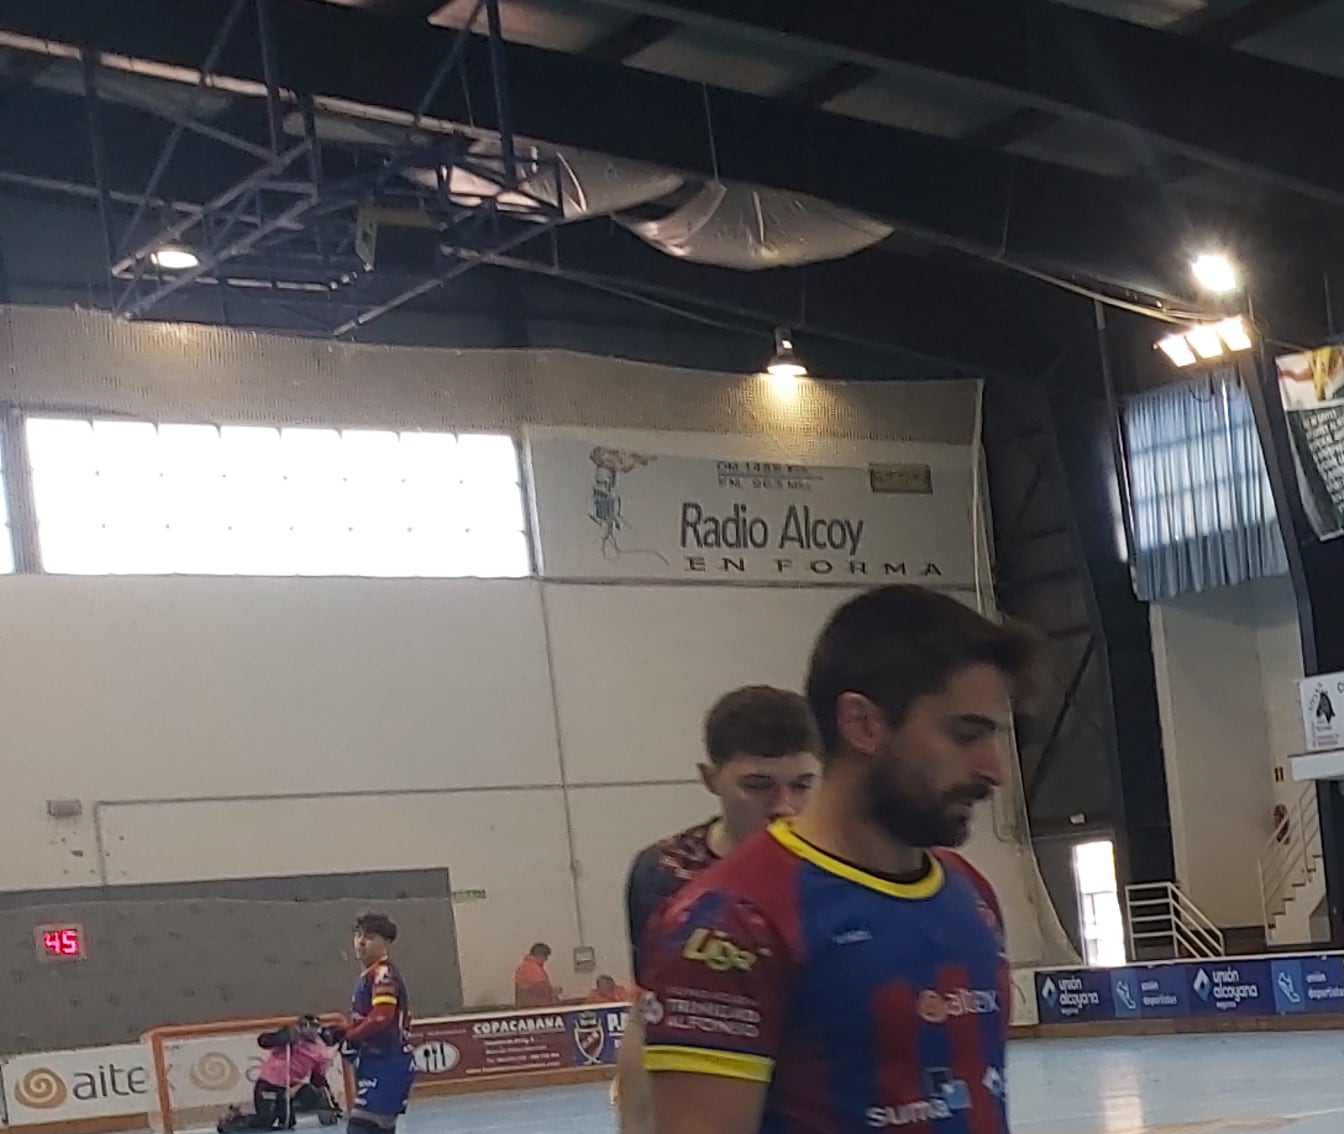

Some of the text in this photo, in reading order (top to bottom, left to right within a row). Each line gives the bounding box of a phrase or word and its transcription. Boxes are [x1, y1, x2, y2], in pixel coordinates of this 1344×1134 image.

[680, 501, 864, 556] Radio Alcoy
[684, 556, 943, 577] EN FORMA
[43, 928, 79, 955] 45
[1213, 966, 1240, 983] unión
[1059, 991, 1100, 1009] alcoyana
[1213, 983, 1259, 1003] alcoyana
[472, 1015, 565, 1035] COPACABANA
[72, 1062, 174, 1101] aite
[866, 1098, 954, 1128] suma
